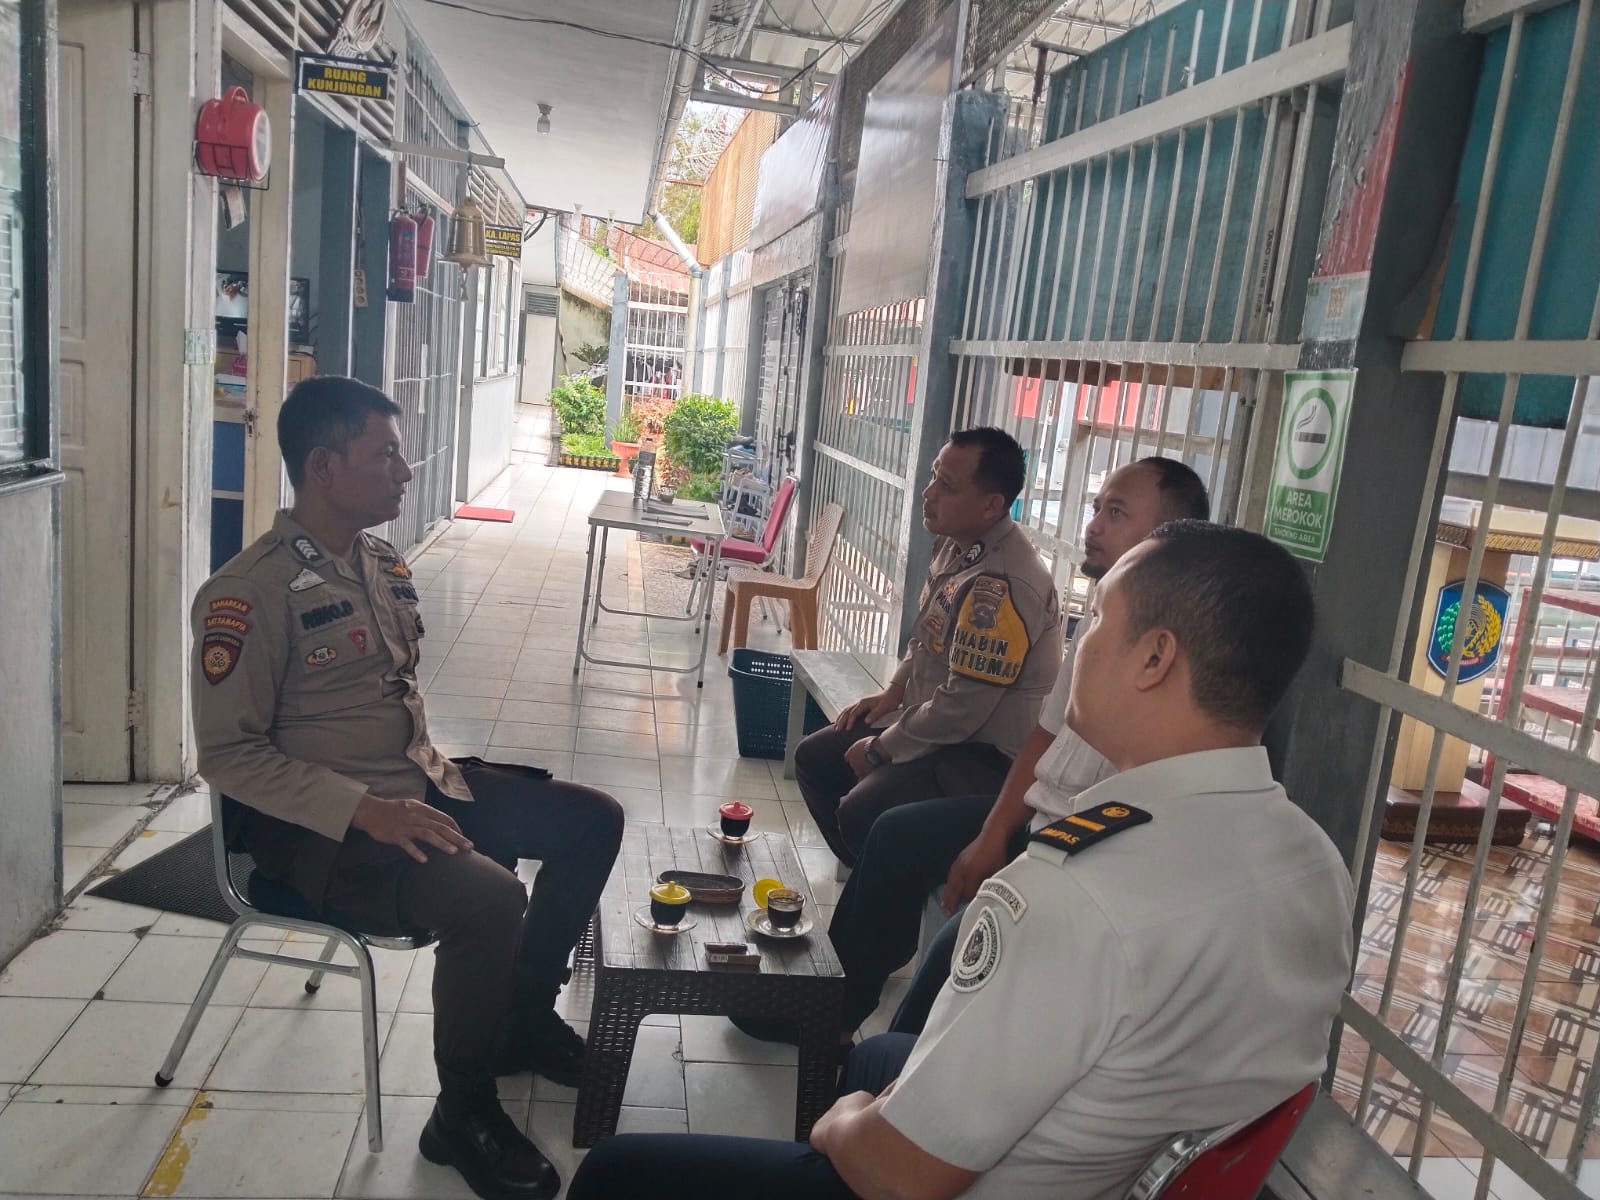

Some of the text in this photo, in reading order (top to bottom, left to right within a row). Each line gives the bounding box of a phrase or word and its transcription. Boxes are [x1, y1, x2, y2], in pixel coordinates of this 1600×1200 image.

[324, 67, 367, 83] RUANG
[307, 78, 382, 97] KUNJUNGAN
[499, 231, 521, 241] LAPAS
[1286, 491, 1312, 508] AREA
[1273, 506, 1323, 528] MEROKOK
[1274, 527, 1316, 544] SMOKING AREA
